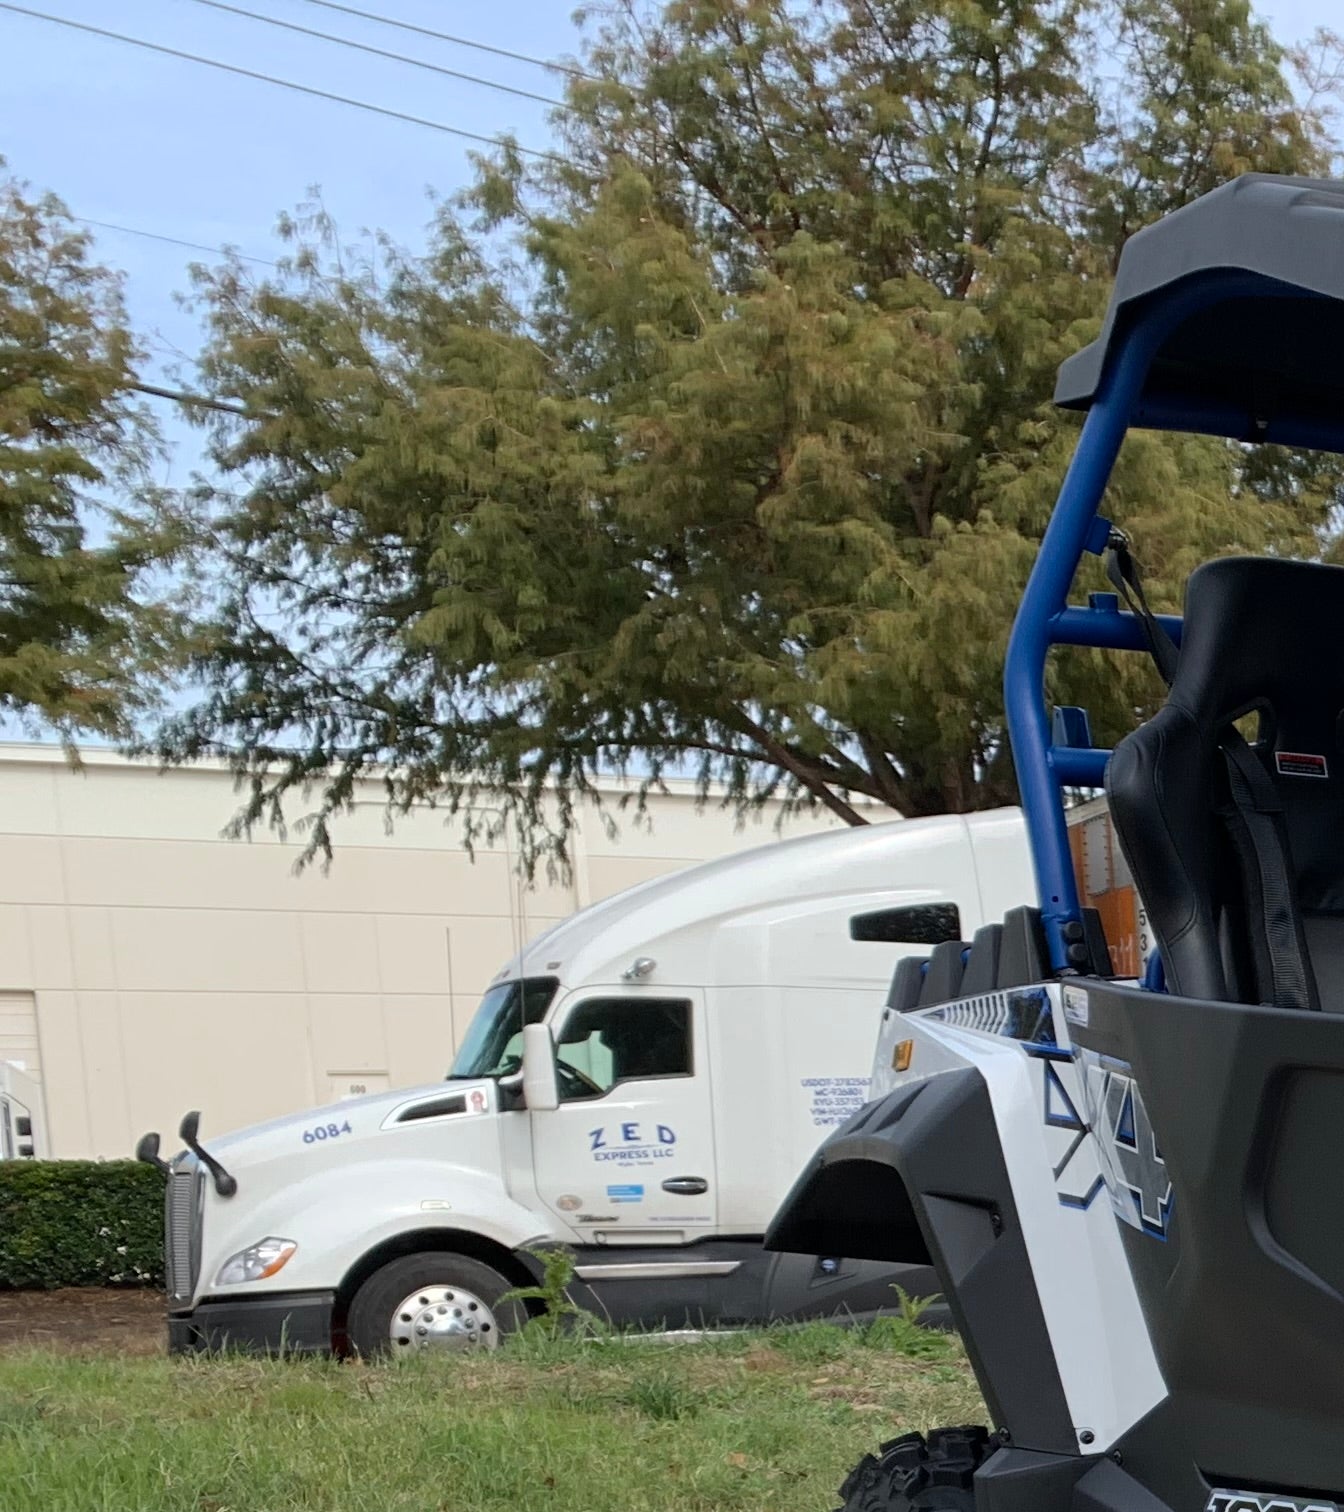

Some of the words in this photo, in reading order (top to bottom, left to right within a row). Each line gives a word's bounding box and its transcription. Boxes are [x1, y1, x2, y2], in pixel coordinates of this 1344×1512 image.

[302, 1120, 352, 1144] 6084
[593, 1150, 649, 1161] EXPRESS
[653, 1148, 675, 1158] LLC
